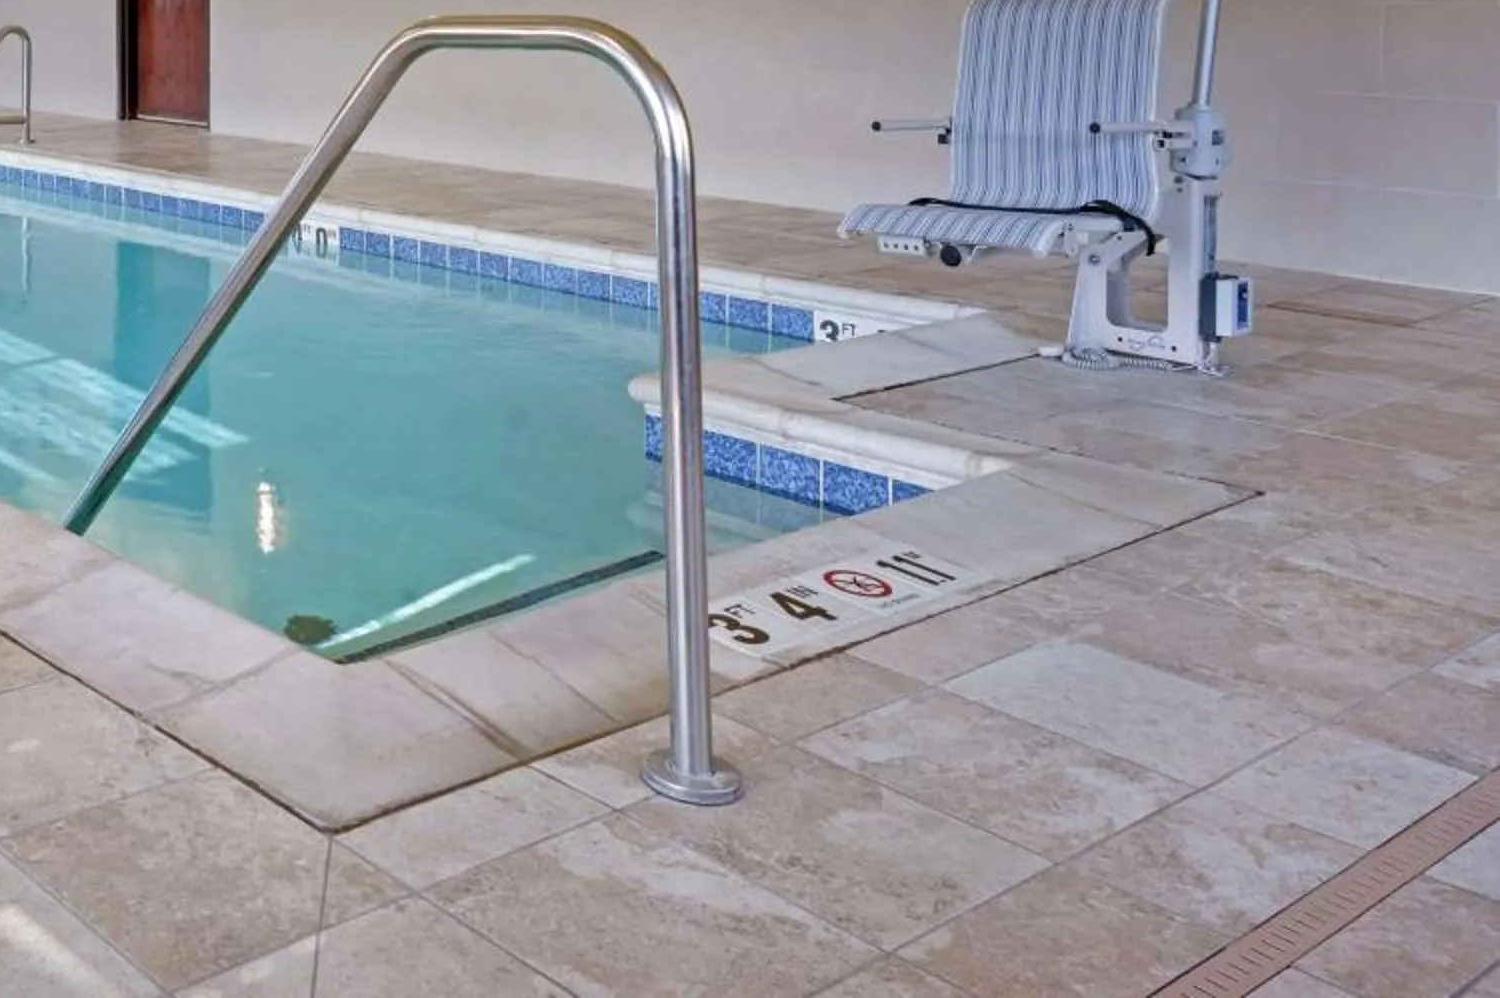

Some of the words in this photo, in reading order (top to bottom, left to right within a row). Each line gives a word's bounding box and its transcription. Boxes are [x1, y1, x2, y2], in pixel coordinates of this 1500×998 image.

[841, 323, 857, 336] FT
[706, 613, 770, 645] 3
[769, 592, 837, 620] 4
